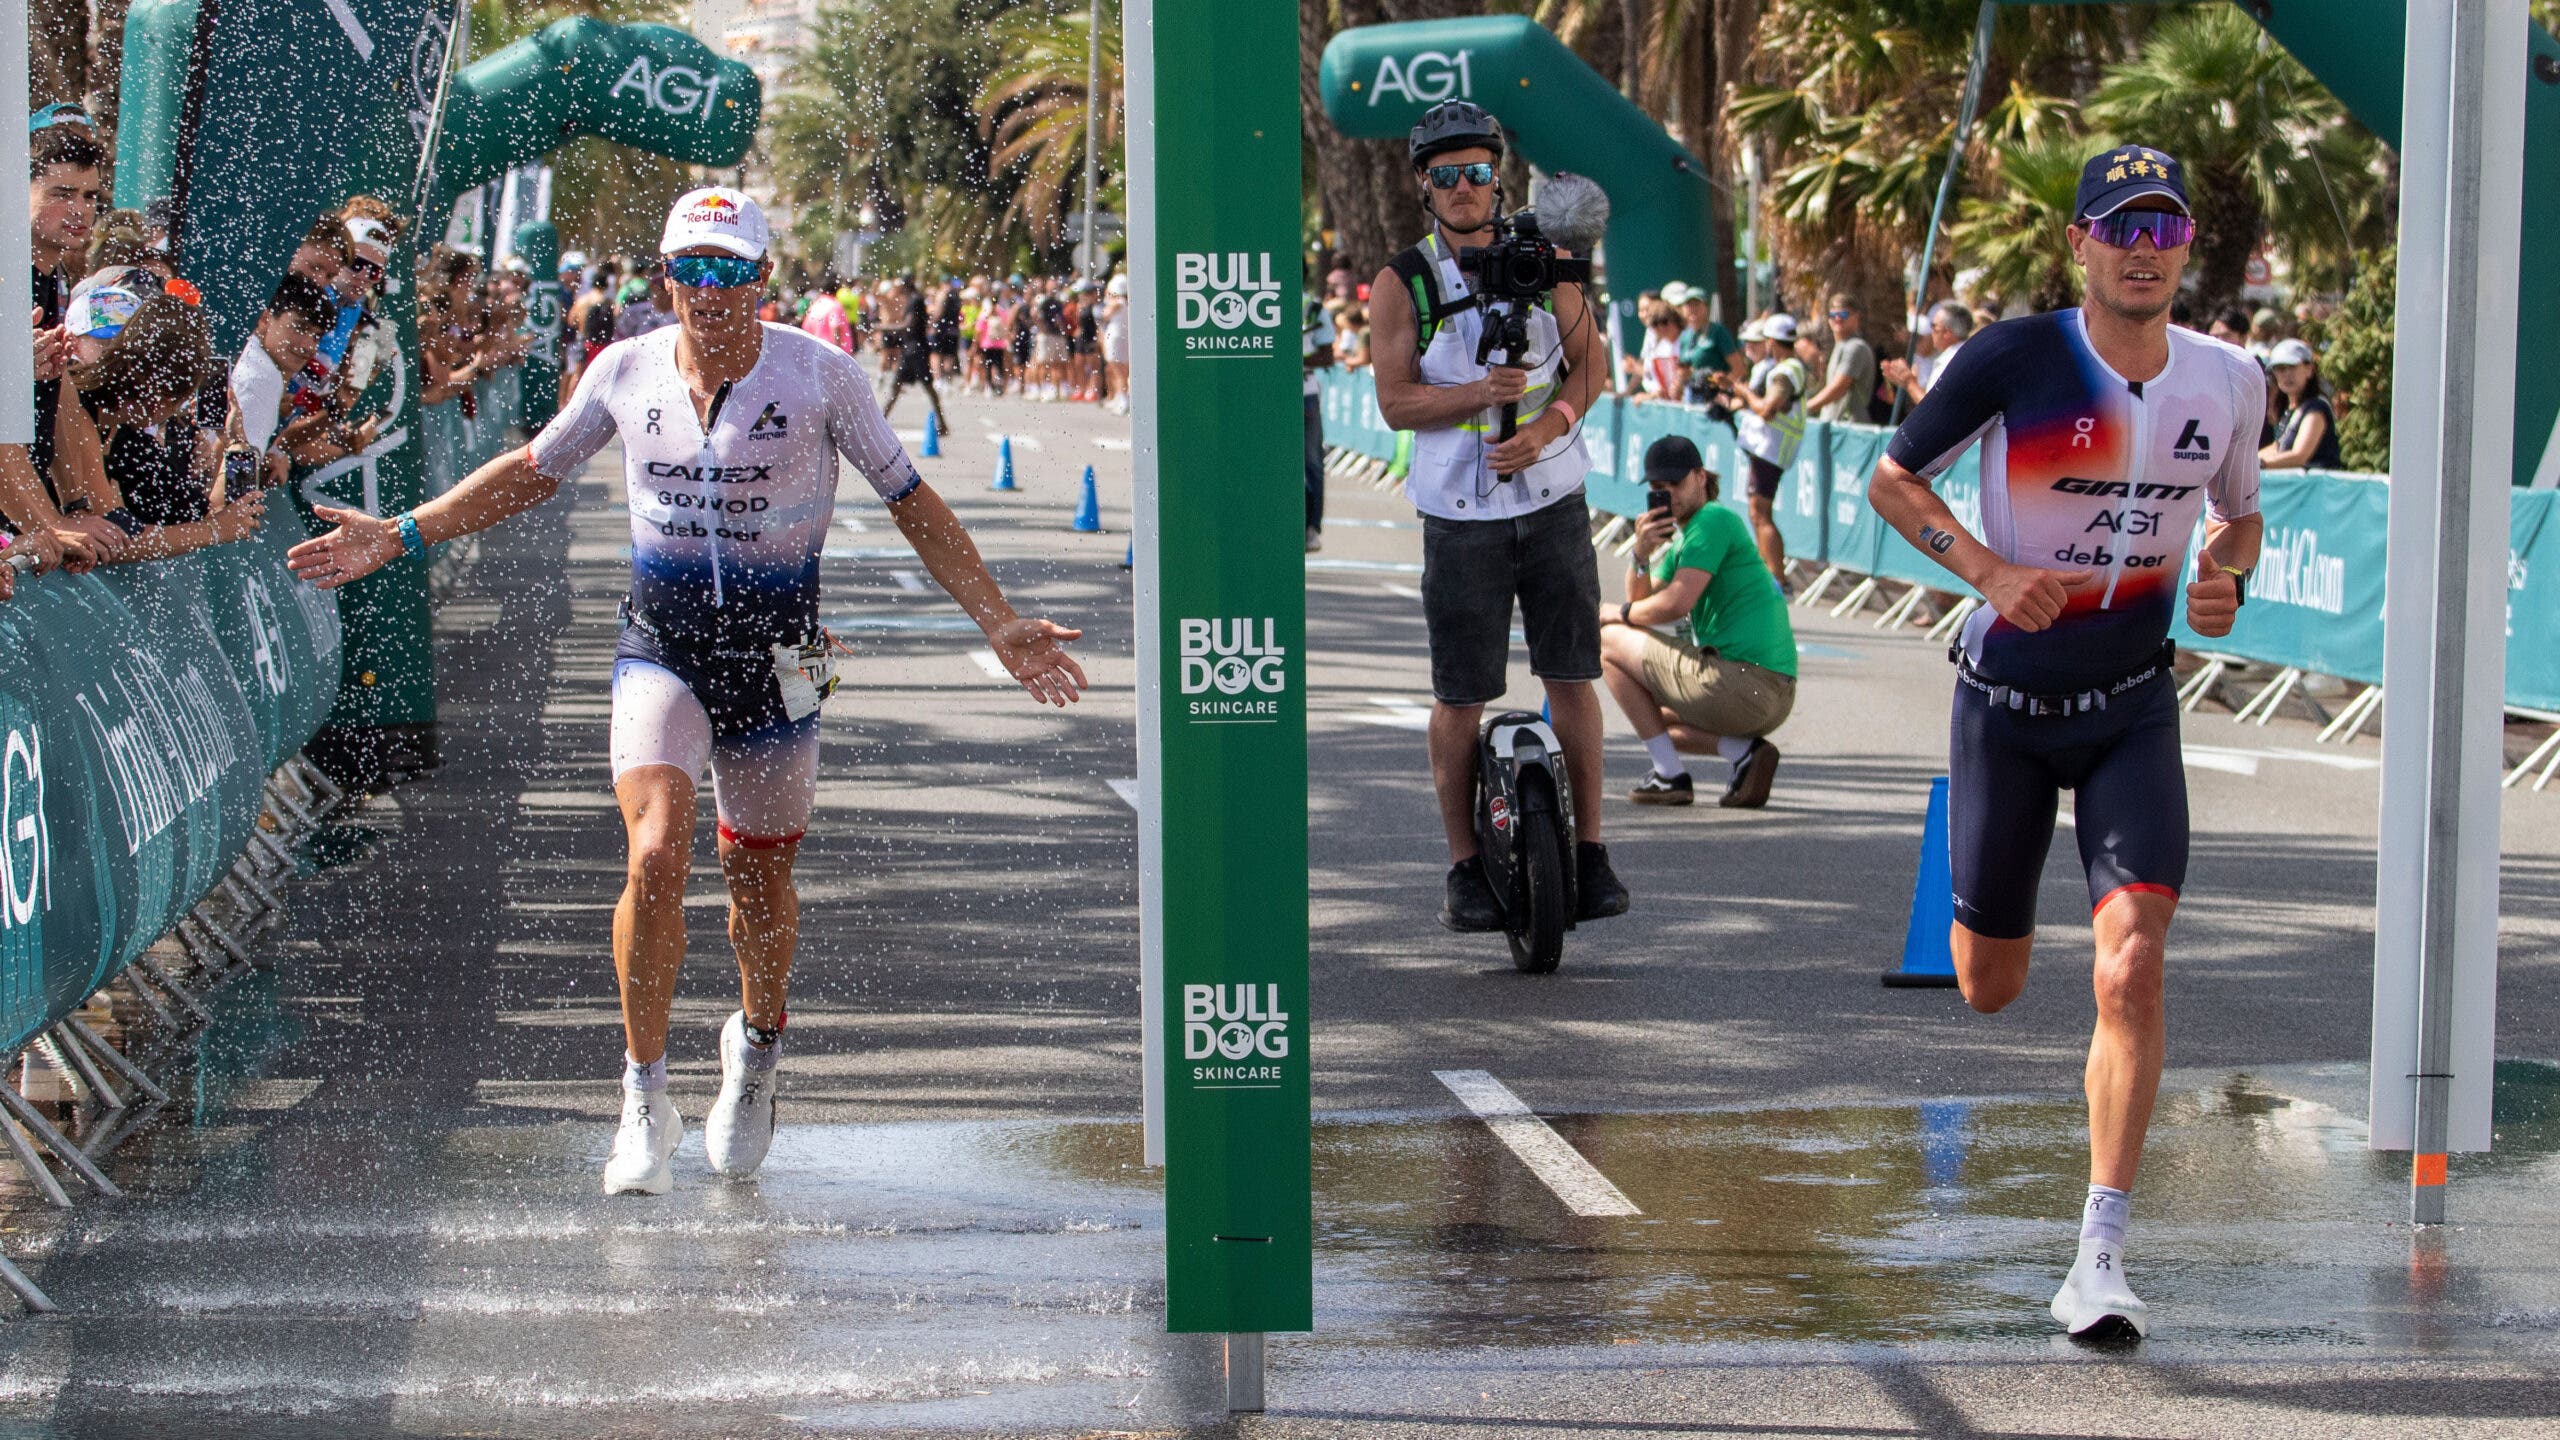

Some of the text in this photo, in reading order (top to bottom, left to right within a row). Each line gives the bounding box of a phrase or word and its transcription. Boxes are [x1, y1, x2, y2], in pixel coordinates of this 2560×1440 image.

[609, 55, 720, 121] AG1
[1367, 49, 1471, 107] AG1
[687, 211, 738, 226] Red Bull
[1176, 252, 1281, 291] BULL
[1177, 290, 1281, 330] DOG
[1185, 336, 1274, 350] SKINCARE
[748, 429, 788, 441] surpas
[2173, 451, 2210, 461] surpas
[648, 461, 775, 483] CADEX
[2051, 477, 2201, 501] GIANT
[661, 521, 761, 541] deboer
[2084, 509, 2163, 537] AG1
[1929, 529, 1956, 556] 6
[2054, 543, 2166, 568] deboer
[1180, 617, 1285, 657] BULL
[1181, 656, 1285, 695] DOG
[1957, 665, 1995, 694] eboer
[2111, 666, 2156, 695] deboer
[1189, 701, 1278, 715] SKINCARE
[0, 724, 51, 929] G1
[1184, 983, 1289, 1022] BULL
[1184, 1021, 1289, 1060] DOG
[1193, 1066, 1282, 1080] SKINCARE
